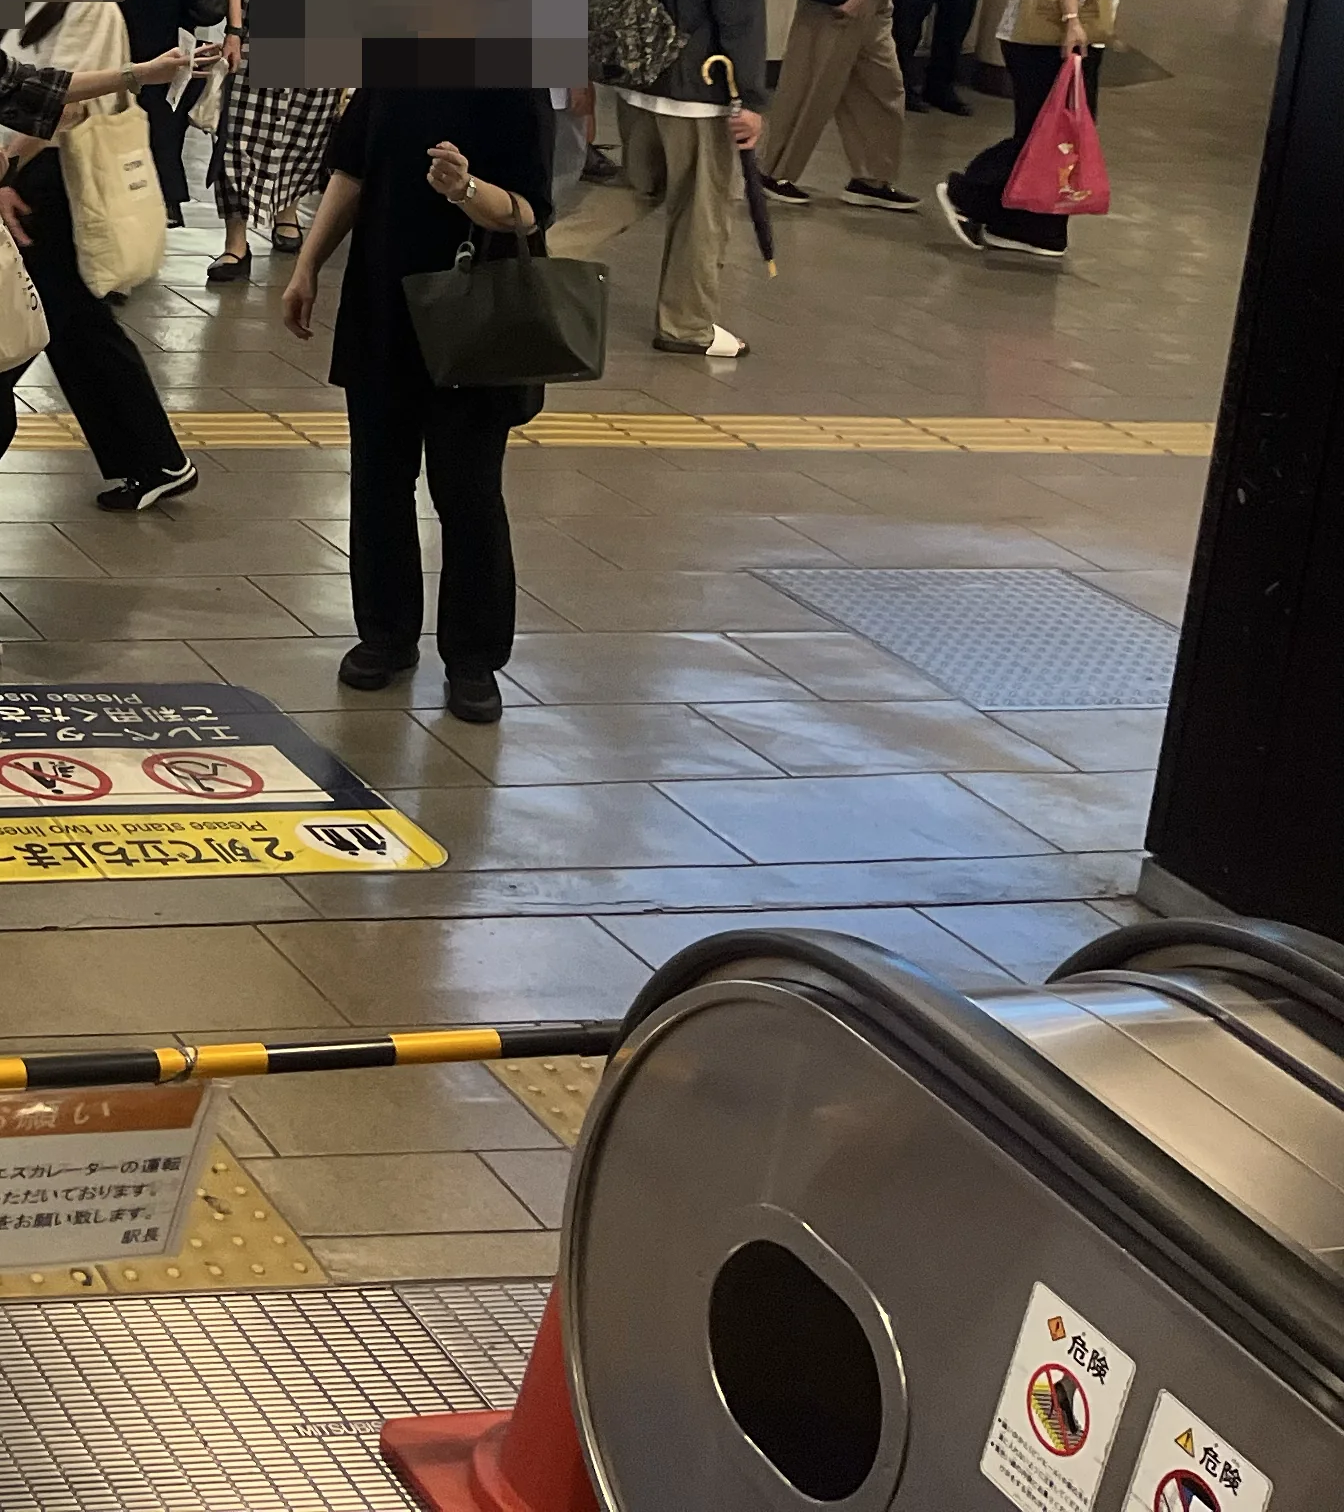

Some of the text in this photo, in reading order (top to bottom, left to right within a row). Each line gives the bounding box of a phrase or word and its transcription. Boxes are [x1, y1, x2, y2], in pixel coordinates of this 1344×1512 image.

[87, 822, 110, 835] in
[115, 820, 186, 835] stand
[192, 819, 268, 833] Please
[121, 1228, 160, 1245] 駅長
[1067, 1334, 1111, 1385] 危険
[1199, 1446, 1244, 1496] 危険
